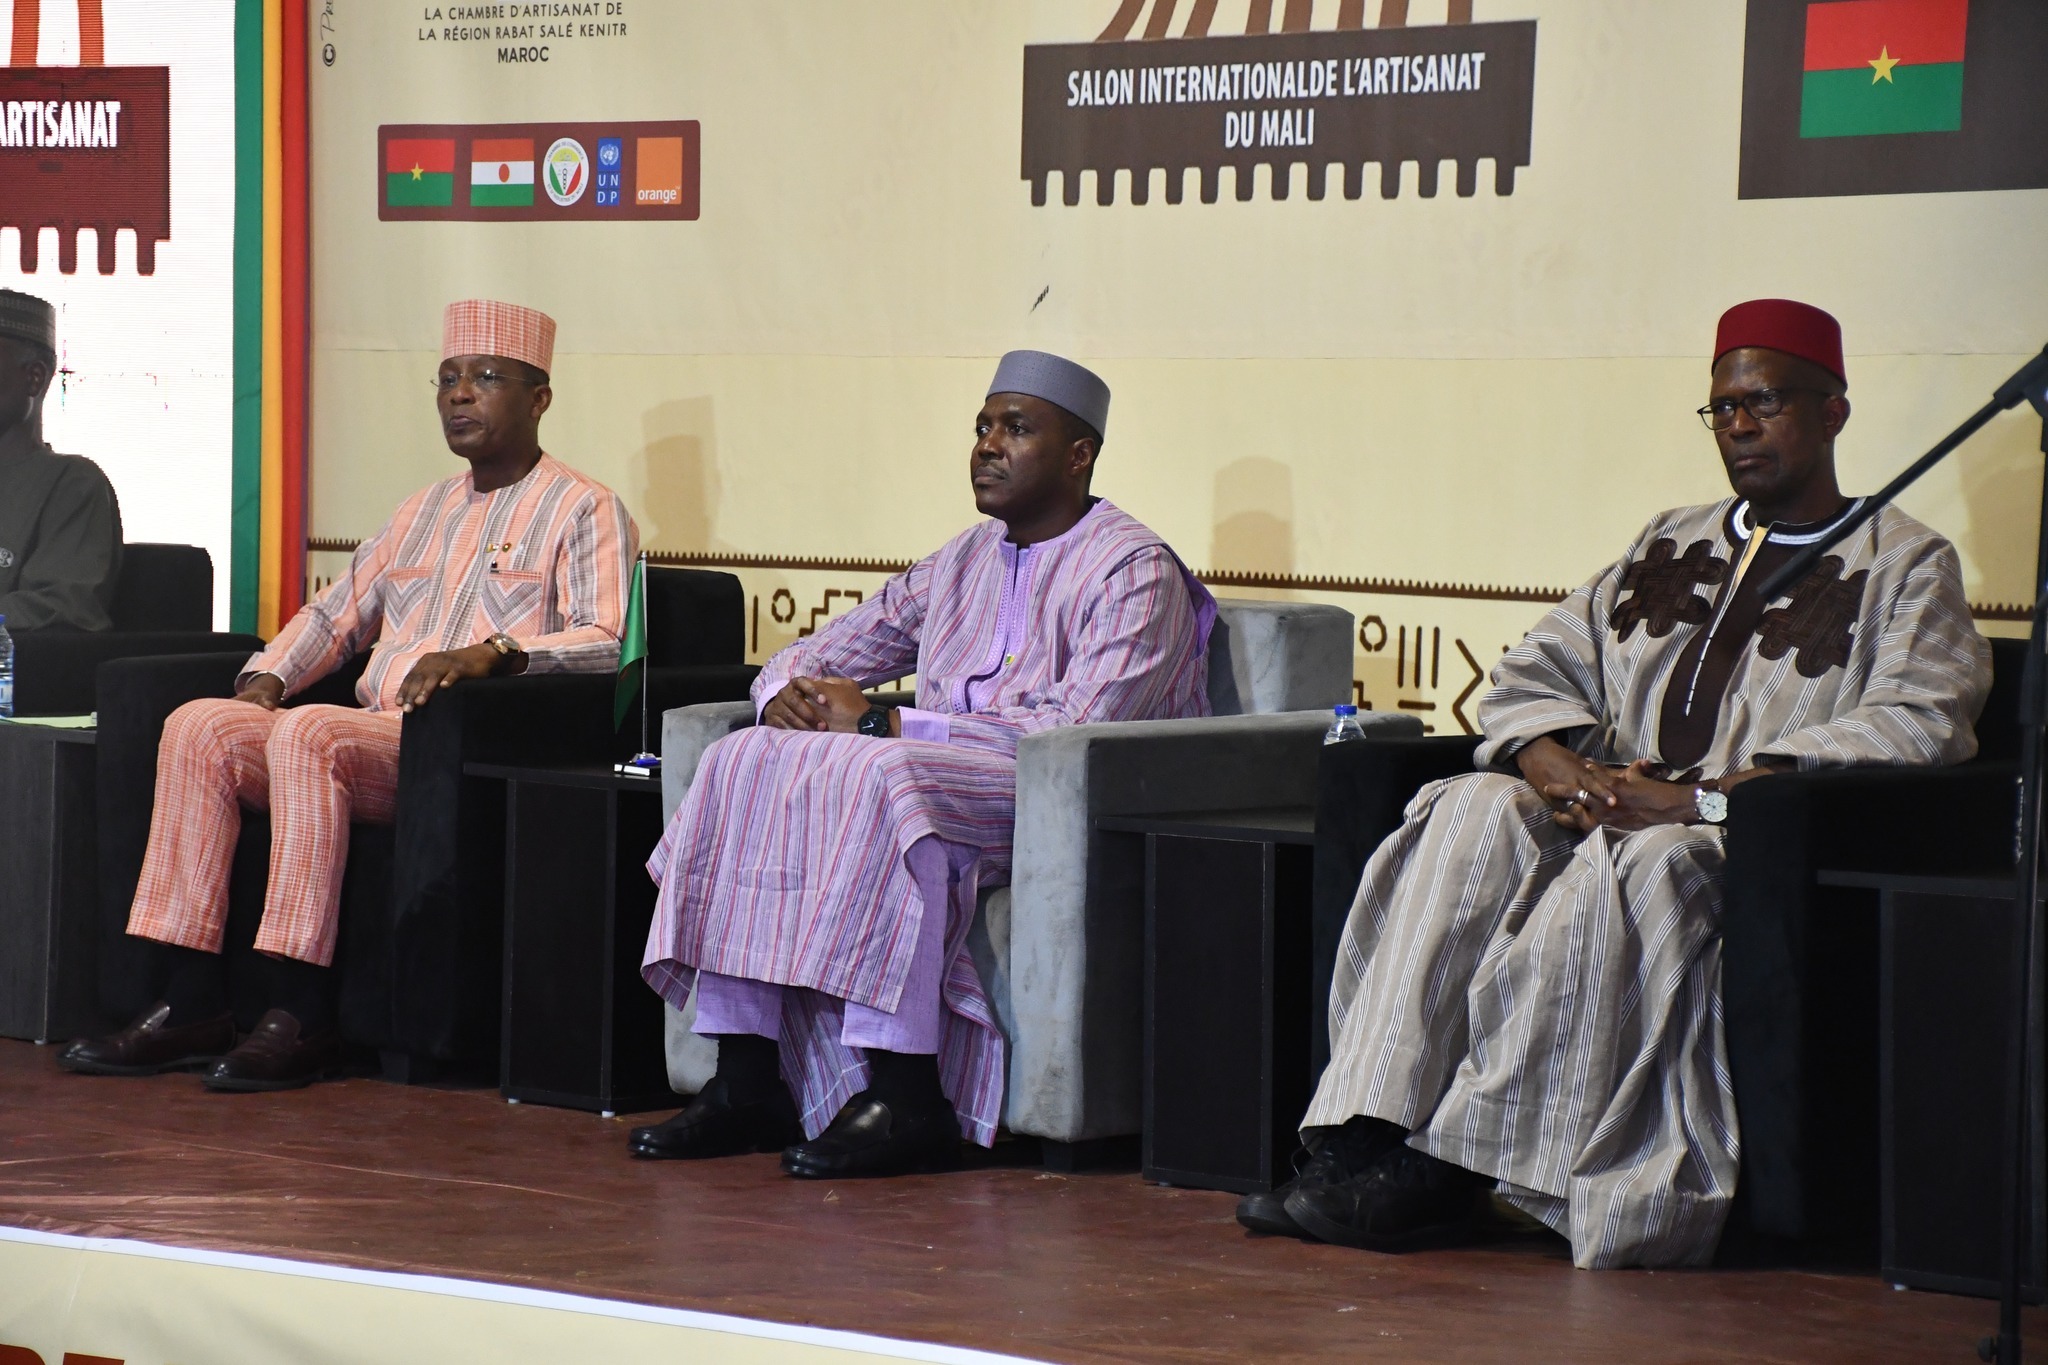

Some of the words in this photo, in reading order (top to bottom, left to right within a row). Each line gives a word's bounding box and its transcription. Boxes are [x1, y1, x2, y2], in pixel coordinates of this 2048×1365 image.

[424, 8, 443, 20] LA
[448, 5, 504, 20] CHAMBRE
[510, 2, 600, 18] D'ARTISANAT
[606, 2, 622, 15] DE
[418, 28, 436, 41] LA
[443, 25, 490, 41] RÉGION
[495, 25, 534, 39] RABAT
[540, 22, 573, 38] SALÉ
[579, 23, 627, 37] KENITR
[497, 46, 549, 63] MAROC
[1067, 68, 1134, 107] SALON
[1343, 52, 1486, 96] L'ARTISANAT
[1225, 110, 1254, 148] DU
[1260, 108, 1315, 147] MALI
[637, 188, 677, 204] orange
